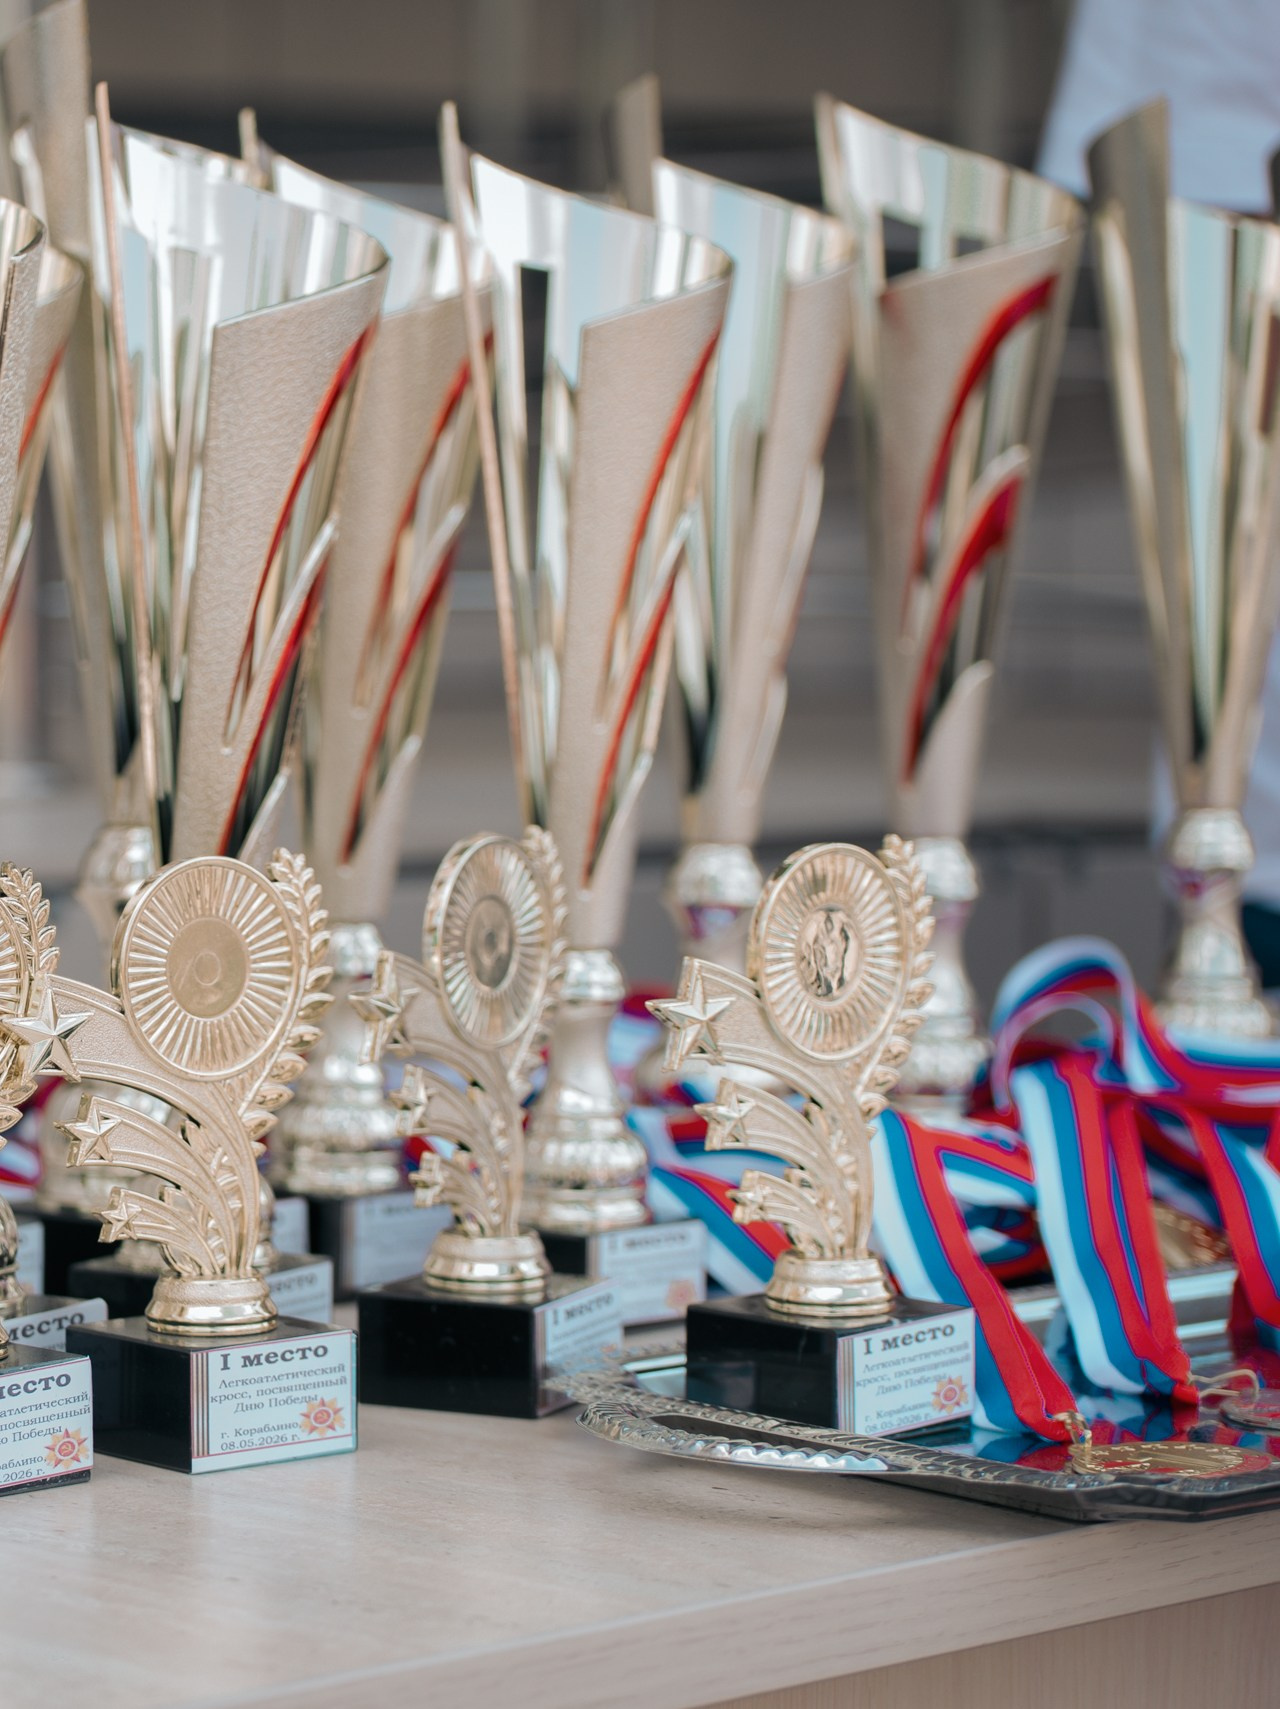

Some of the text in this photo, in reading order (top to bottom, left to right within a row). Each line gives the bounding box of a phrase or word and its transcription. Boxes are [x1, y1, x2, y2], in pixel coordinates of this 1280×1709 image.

[881, 1324, 955, 1351] место
[241, 1345, 328, 1368] место
[219, 1363, 346, 1389] Легкоатлетический
[210, 1376, 347, 1404] кросс, посвященный
[234, 1394, 318, 1414] Дню Победы
[0, 1404, 91, 1431] посвященный
[12, 1425, 62, 1442] Победы
[221, 1434, 288, 1451] 08.05.2026
